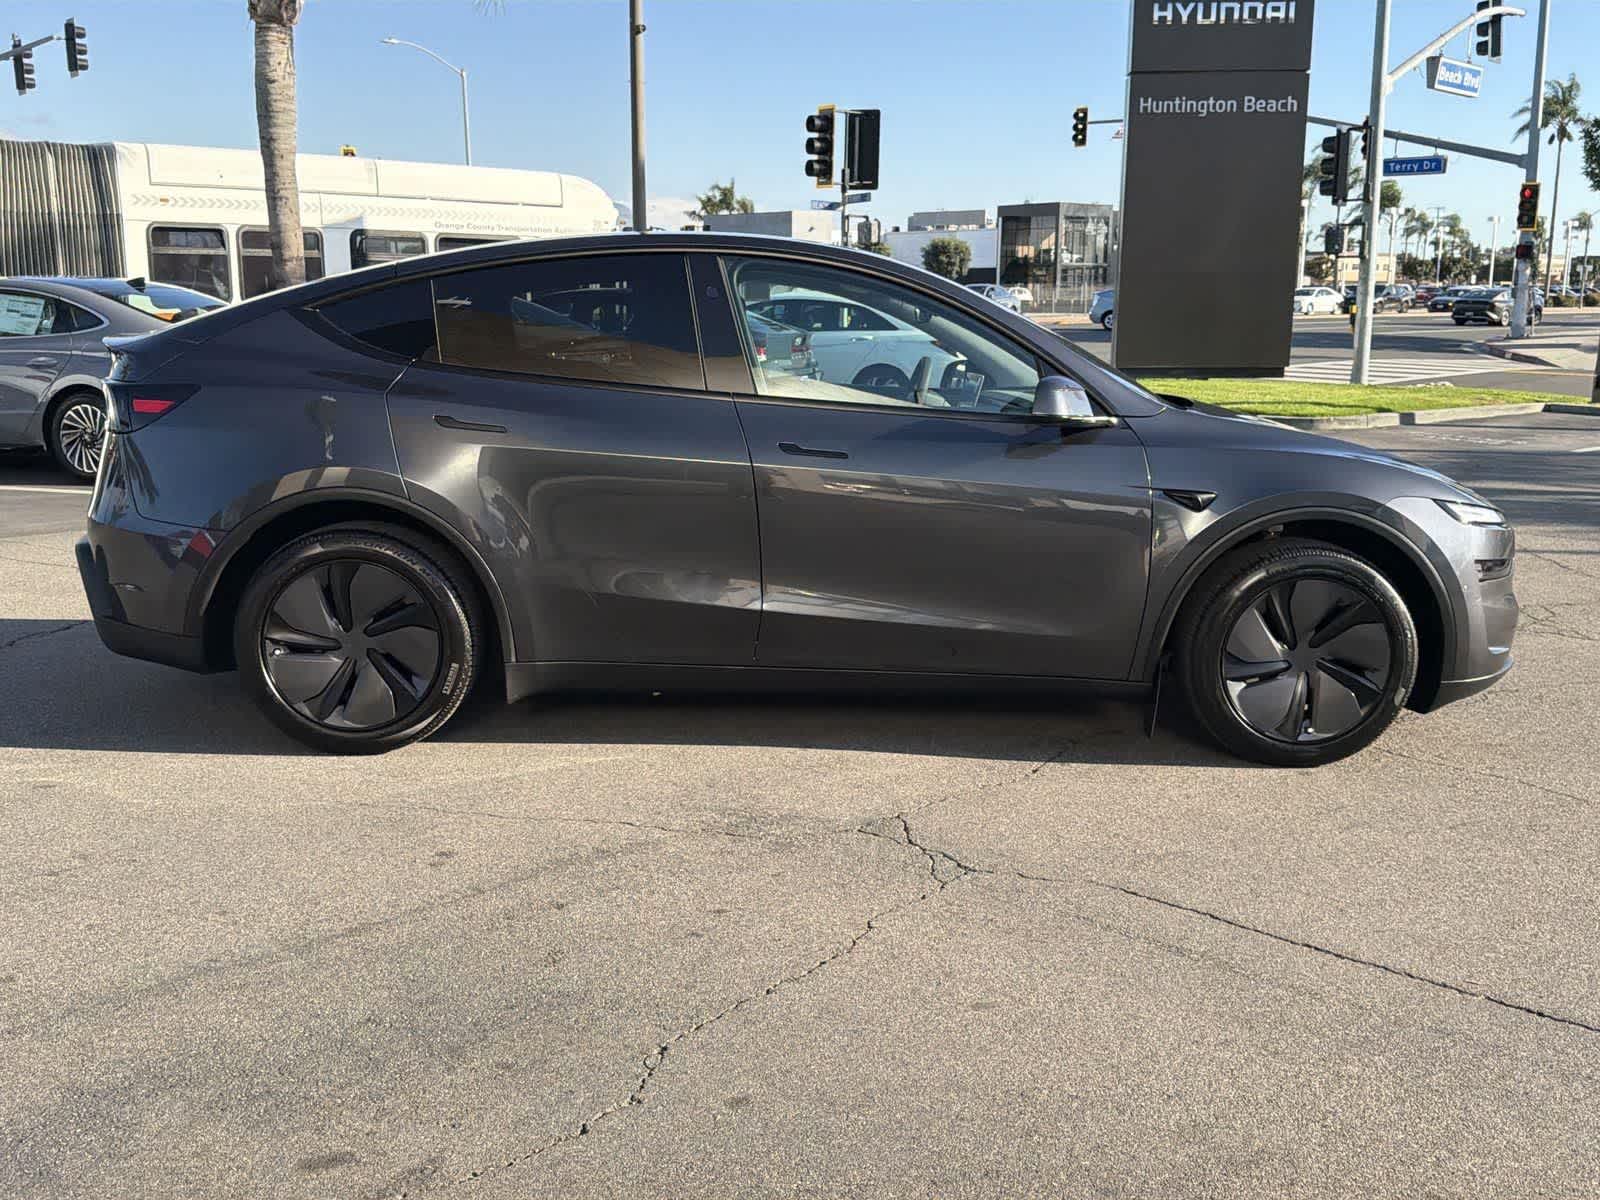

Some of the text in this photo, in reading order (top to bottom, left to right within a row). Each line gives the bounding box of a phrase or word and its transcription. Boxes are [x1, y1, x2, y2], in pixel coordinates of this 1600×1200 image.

[1152, 1, 1296, 25] HYUNDAI
[1439, 65, 1481, 89] Beach Blvd
[1139, 95, 1298, 118] Huntington Beach
[1389, 161, 1436, 172] Terry Dr
[434, 221, 465, 231] Orange
[466, 222, 495, 232] County
